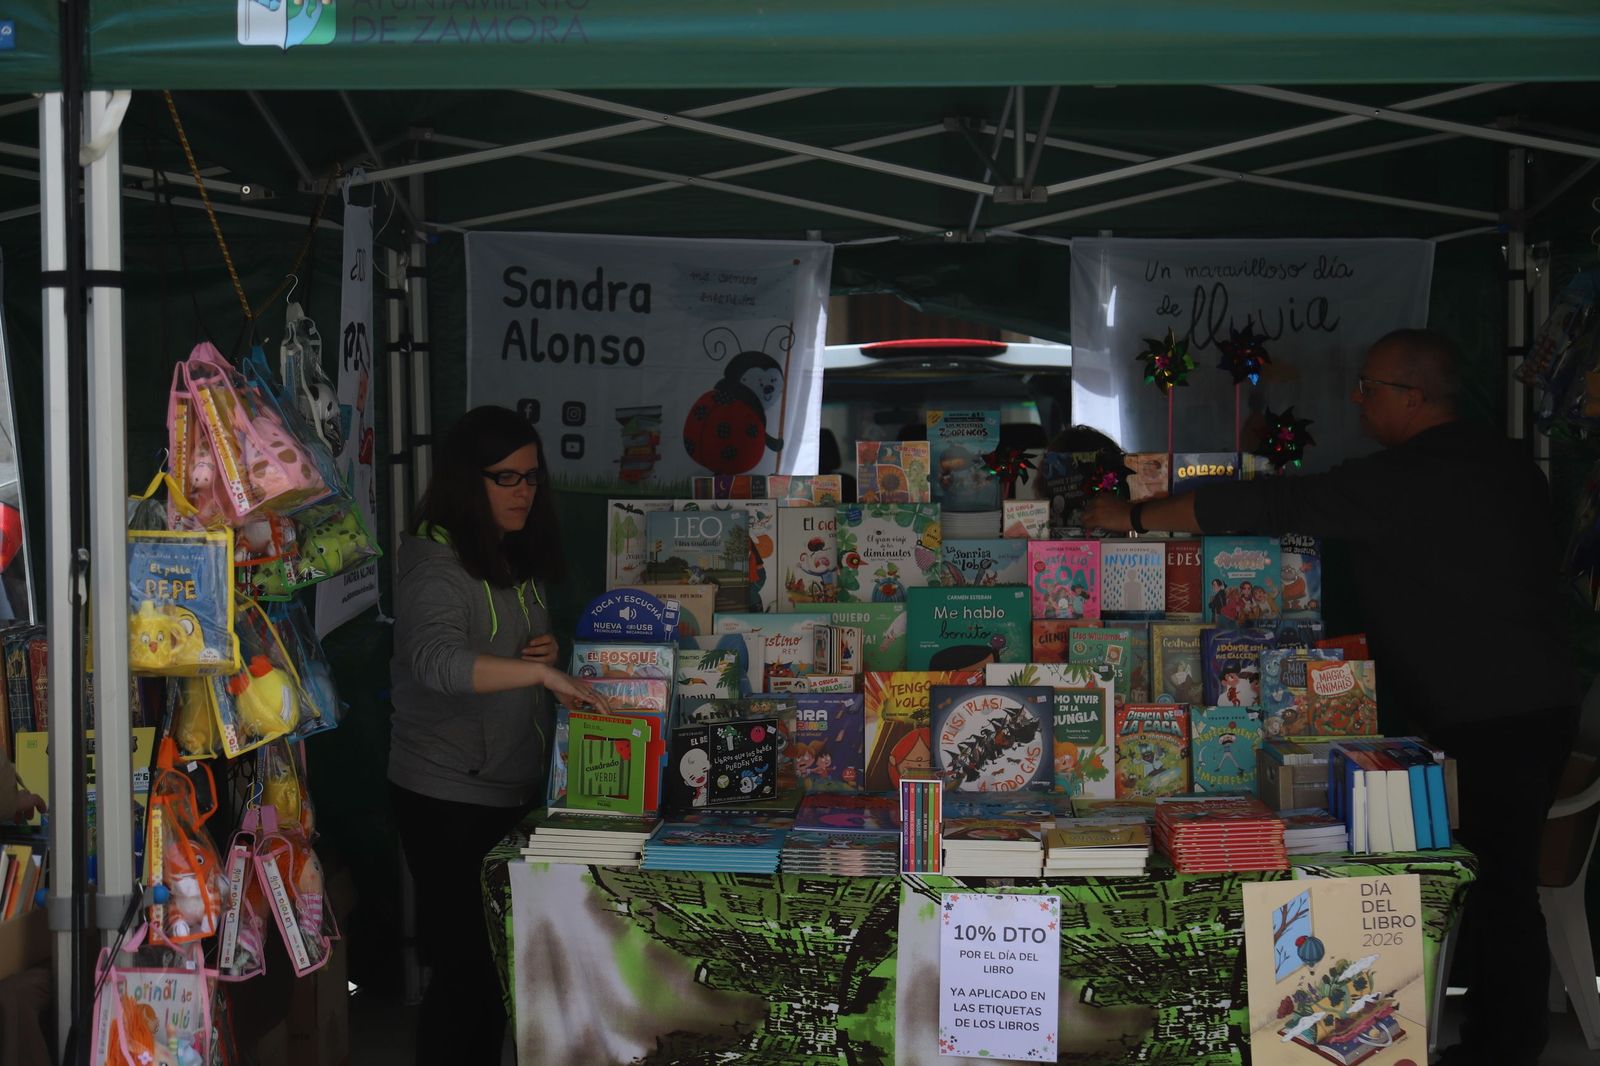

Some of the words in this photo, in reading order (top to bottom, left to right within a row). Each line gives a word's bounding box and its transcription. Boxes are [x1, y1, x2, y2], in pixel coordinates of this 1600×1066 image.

[351, 16, 399, 44] DE
[412, 15, 590, 44] ZAMORA
[1145, 258, 1171, 282] Un
[1184, 256, 1307, 281] maravilloso
[1312, 254, 1354, 281] día
[502, 266, 652, 314] Sandra
[1157, 295, 1184, 318] de
[501, 318, 646, 367] Alonso
[1177, 463, 1235, 479] GOLAZOS
[803, 517, 814, 531] El
[862, 549, 912, 558] diminutos
[150, 563, 162, 574] El
[145, 578, 198, 600] PEPE
[591, 599, 614, 617] TOCA
[624, 595, 662, 620] ESCUCHA
[934, 606, 959, 620] Me
[963, 605, 1005, 619] hablo
[593, 622, 622, 630] NUEVA
[832, 612, 871, 624] QUIERO
[940, 620, 992, 640] bonito
[587, 652, 598, 661] EL
[600, 650, 658, 666] BOSQUE
[1319, 669, 1346, 682] MAGIC
[890, 681, 932, 699] TENGO
[1315, 676, 1353, 694] ANIMALS
[1053, 694, 1071, 704] MO
[1073, 694, 1100, 705] VIVIR
[966, 698, 1004, 719] ¡PLAS!
[1060, 704, 1069, 712] EN
[1071, 704, 1079, 712] LA
[1127, 710, 1162, 721] CIENCIA
[1163, 710, 1175, 721] DE
[1053, 710, 1099, 727] JUNGLA
[1120, 720, 1141, 735] LA
[1142, 720, 1184, 736] CACA
[690, 737, 699, 746] EL
[585, 759, 620, 773] cuadrado
[725, 759, 751, 772] PUEDEN
[750, 754, 764, 766] VER
[1020, 746, 1042, 773] GAS
[594, 772, 618, 783] VERDE
[990, 774, 1026, 792] TODO
[1360, 881, 1393, 897] DÍA
[1361, 899, 1397, 914] DEL
[1362, 914, 1417, 930] LIBRO
[953, 924, 998, 943] 10%
[1002, 926, 1048, 945] DTO
[1362, 931, 1404, 948] 2026
[959, 950, 981, 962] POR
[983, 950, 996, 962] EL
[998, 949, 1017, 962] DÍA
[1018, 952, 1039, 963] DEL
[983, 964, 1015, 976] LIBRO
[134, 979, 178, 1002] orinal
[949, 987, 966, 999] YA
[968, 988, 1028, 1001] APLICADO
[1030, 990, 1047, 1001] EN
[953, 1003, 974, 1016] LAS
[976, 1004, 1043, 1020] ETIQUETAS
[954, 1017, 968, 1029] DE
[970, 1018, 994, 1031] LOS
[997, 1018, 1040, 1032] LIBROS
